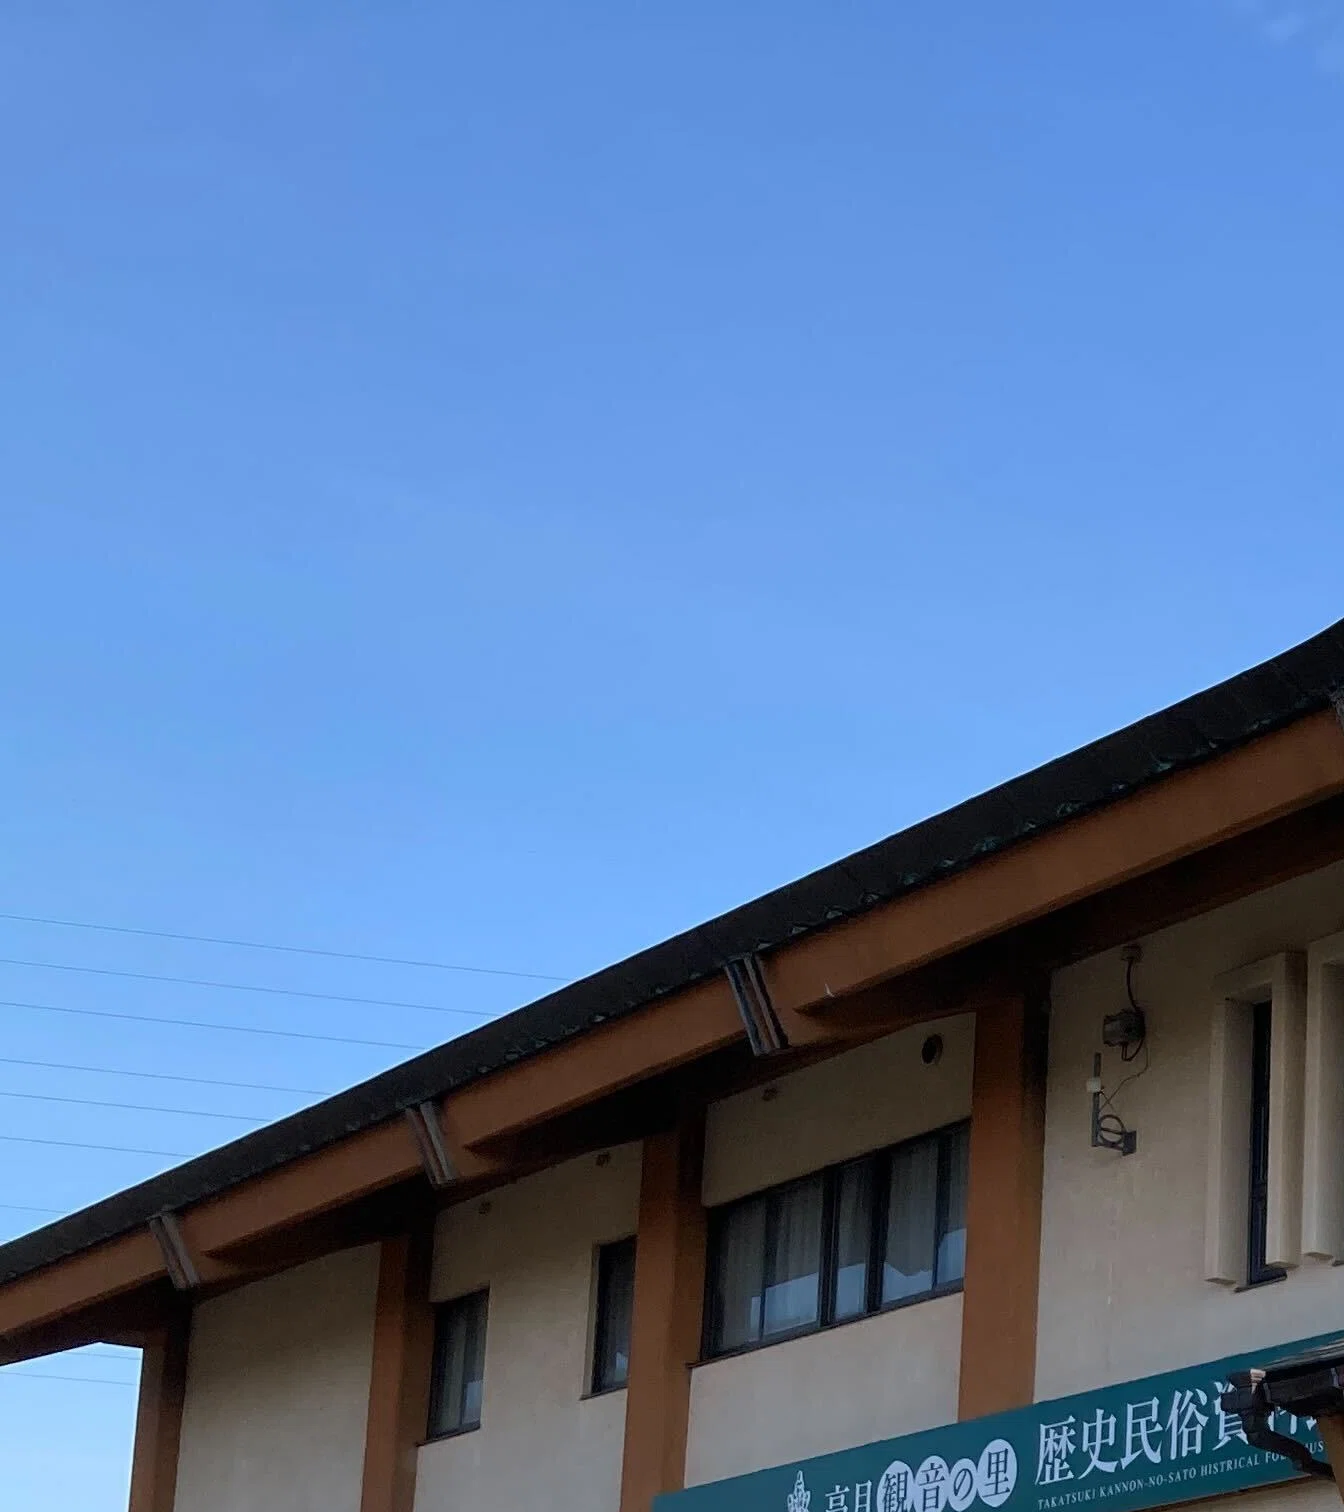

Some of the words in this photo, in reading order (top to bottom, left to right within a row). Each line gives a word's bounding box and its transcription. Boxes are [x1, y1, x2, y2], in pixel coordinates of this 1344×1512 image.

[1034, 1381, 1318, 1486] 歴史民俗資
[1037, 1489, 1096, 1511] TAKATSUKI
[1099, 1467, 1197, 1498] KANNON-NO-SATO
[1200, 1453, 1261, 1477] HISTRICAL
